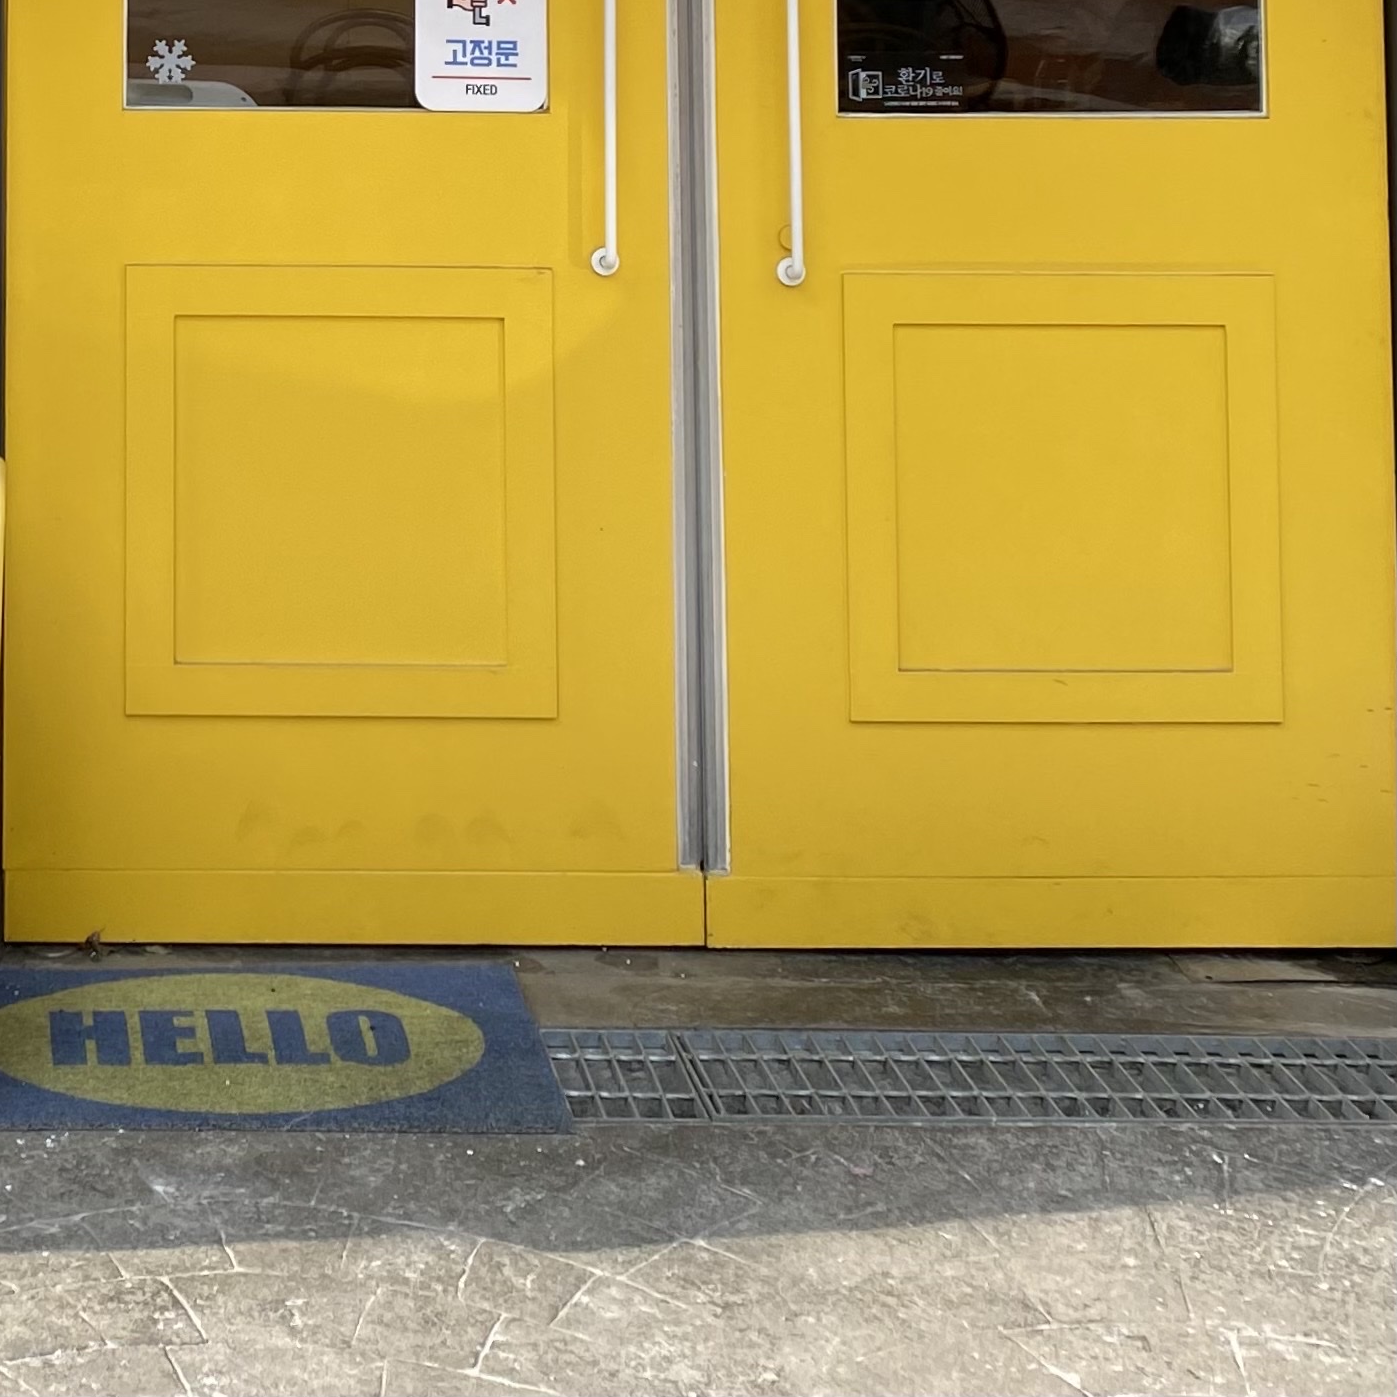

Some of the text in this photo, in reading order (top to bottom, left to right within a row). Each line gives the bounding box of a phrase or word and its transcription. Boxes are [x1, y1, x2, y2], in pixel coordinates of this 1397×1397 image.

[444, 39, 519, 68] 고정문
[897, 67, 945, 85] 환기로
[465, 84, 498, 96] FIXED
[883, 84, 934, 99] 코로나19
[49, 1009, 412, 1066] HELLO
